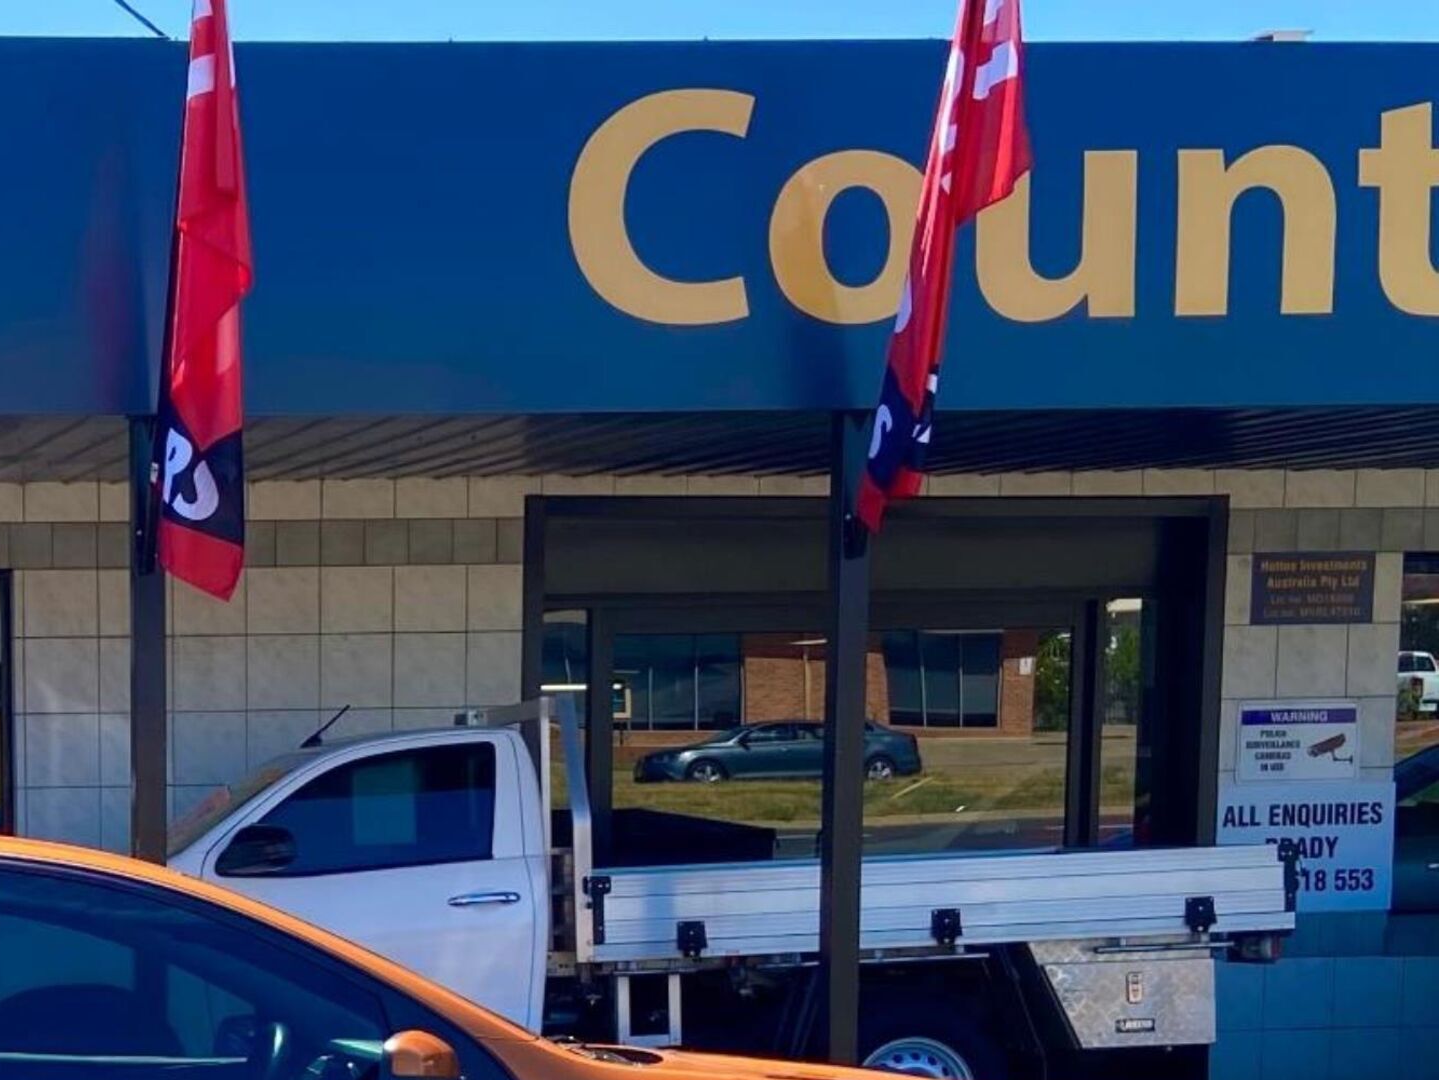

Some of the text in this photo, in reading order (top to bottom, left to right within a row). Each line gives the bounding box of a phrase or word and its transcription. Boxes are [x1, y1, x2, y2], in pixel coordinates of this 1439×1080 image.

[1267, 575, 1360, 590] Australia Pty Ltd
[1271, 710, 1328, 722] WARNING
[1222, 802, 1383, 829] ALL ENQUIRIES
[1265, 836, 1339, 859] ADY
[1334, 867, 1374, 892] 553
